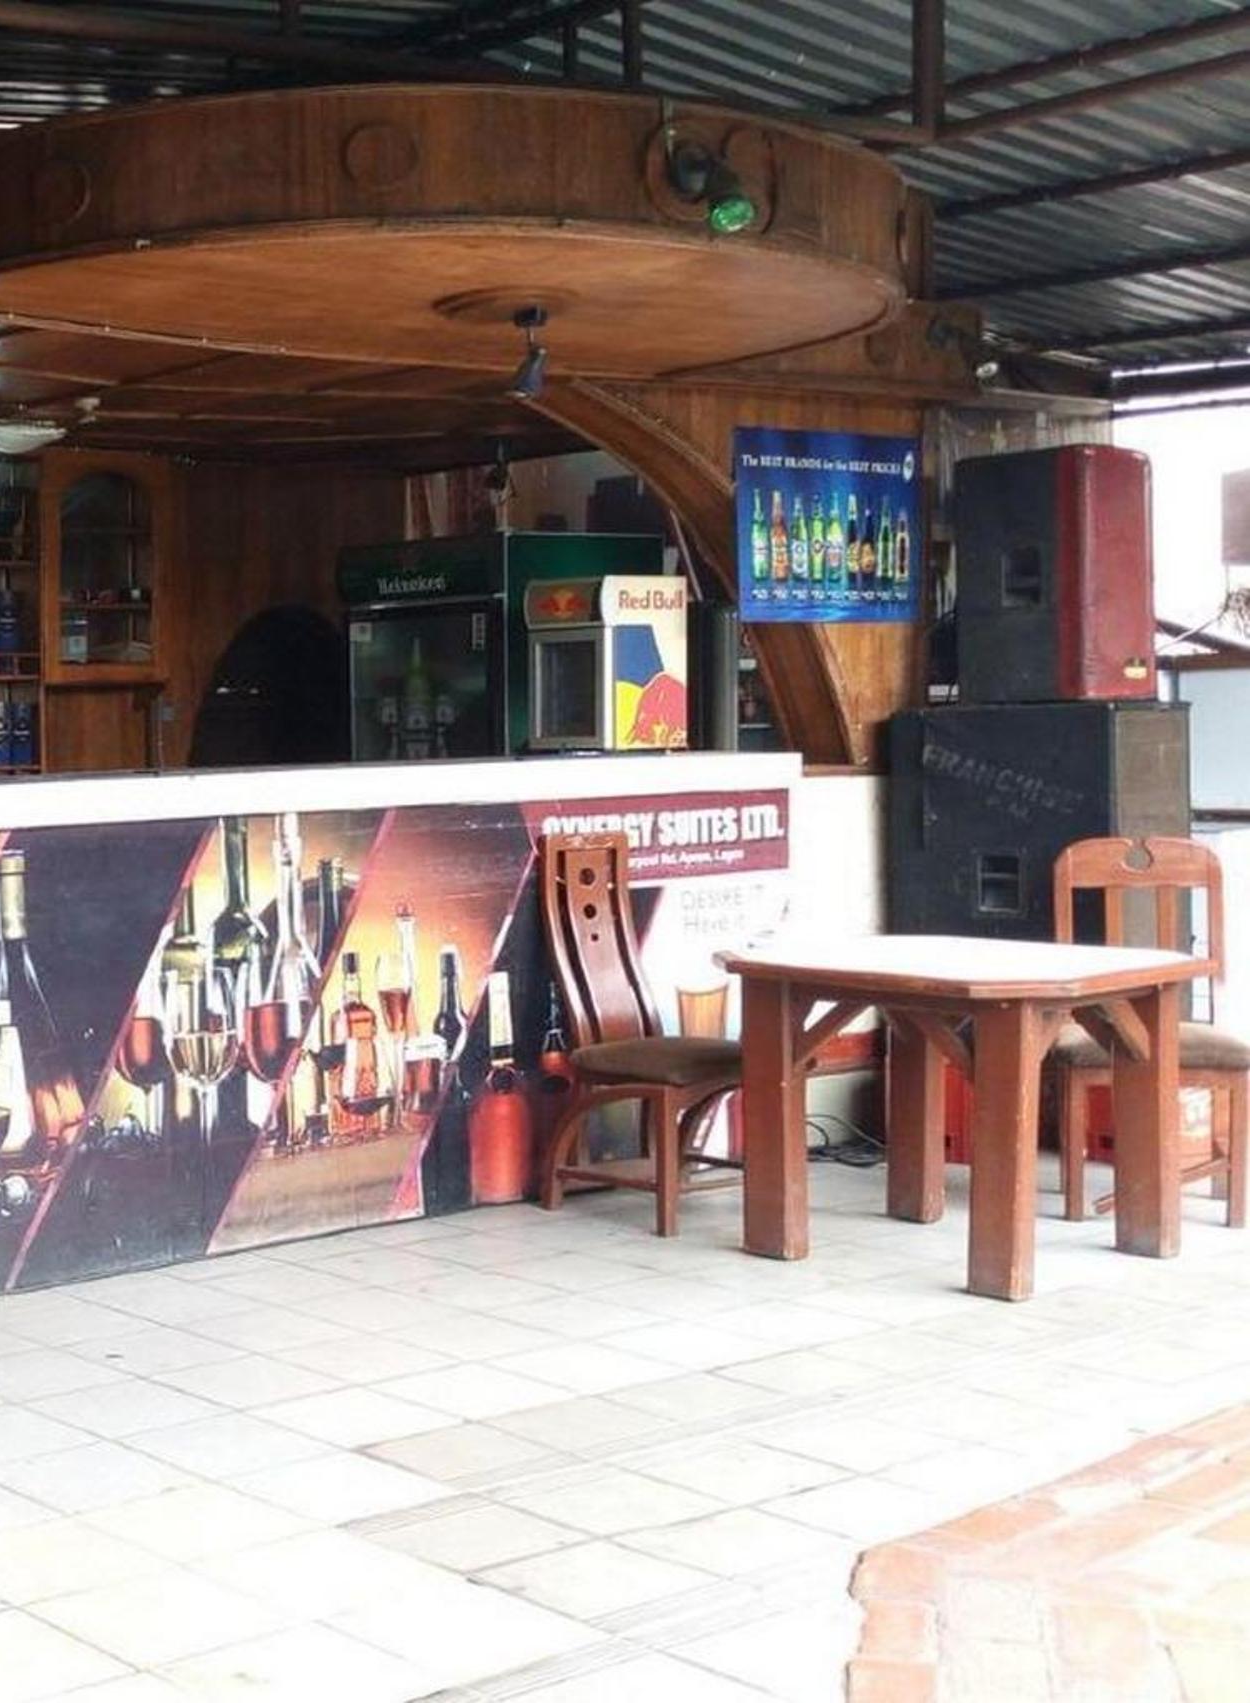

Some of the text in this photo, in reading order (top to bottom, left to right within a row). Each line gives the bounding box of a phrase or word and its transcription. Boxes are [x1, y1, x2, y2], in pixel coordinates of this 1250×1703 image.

[377, 575, 446, 595] Heineken
[618, 588, 684, 610] Red Bull
[657, 808, 738, 846] SUITES
